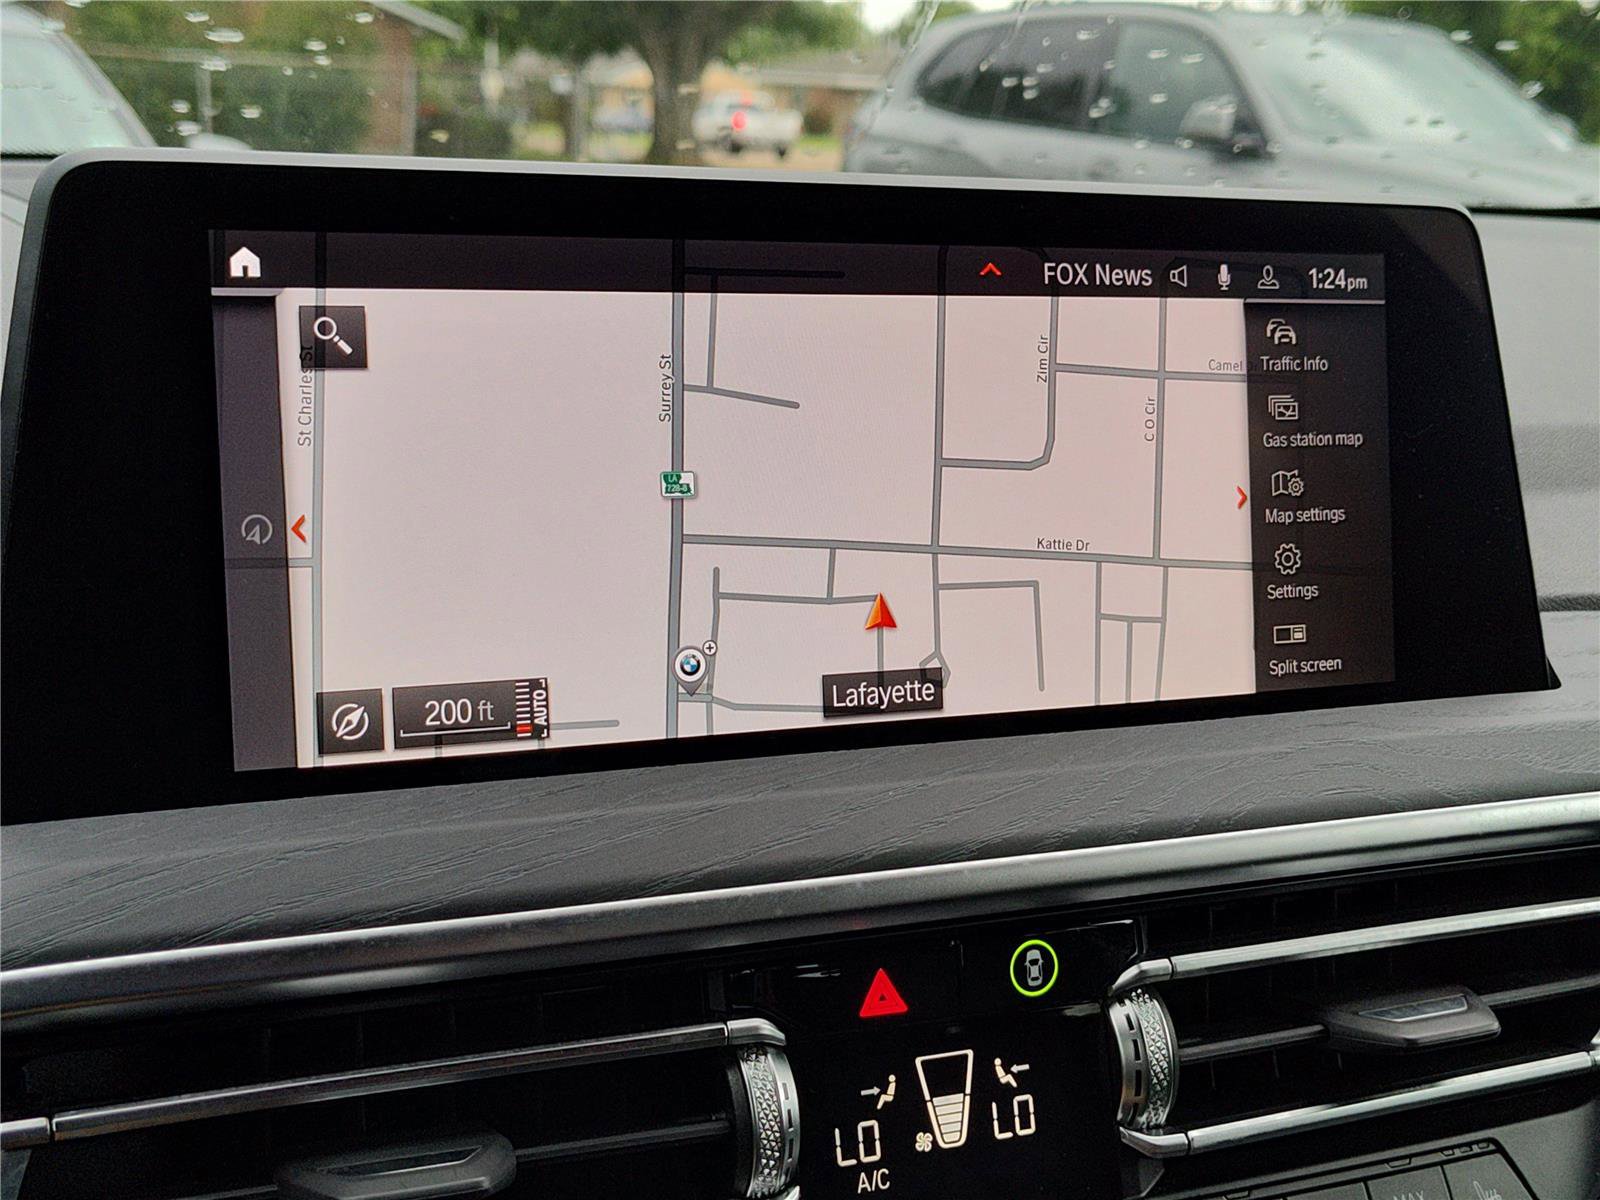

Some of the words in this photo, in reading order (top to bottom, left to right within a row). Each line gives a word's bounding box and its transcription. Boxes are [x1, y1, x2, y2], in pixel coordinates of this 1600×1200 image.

[1043, 262, 1089, 286] FOX
[1095, 263, 1152, 287] News
[1308, 267, 1368, 291] 1:24pm
[1037, 334, 1049, 353] Cir
[659, 353, 672, 370] St
[1036, 356, 1048, 384] Zim
[1208, 358, 1243, 372] Camel
[1259, 355, 1301, 372] Traffic
[1303, 355, 1328, 372] Info
[298, 366, 313, 426] Charles
[658, 373, 674, 423] Surrey
[1144, 396, 1156, 415] Cir
[297, 430, 312, 447] St
[1144, 430, 1155, 442] C
[1263, 432, 1288, 448] Gas
[1289, 431, 1333, 447] station
[1335, 433, 1363, 449] map
[1265, 508, 1294, 524] Map
[1296, 507, 1346, 523] settings
[1036, 537, 1073, 551] Kattie
[1076, 538, 1090, 552] Dr
[1267, 583, 1319, 600] Settings
[1269, 658, 1298, 676] Split
[1300, 658, 1342, 673] screen
[832, 680, 935, 709] Lafayette
[424, 698, 472, 726] 200
[476, 699, 495, 722] ft
[532, 689, 548, 726] AUTO
[857, 1168, 891, 1194] A/C
